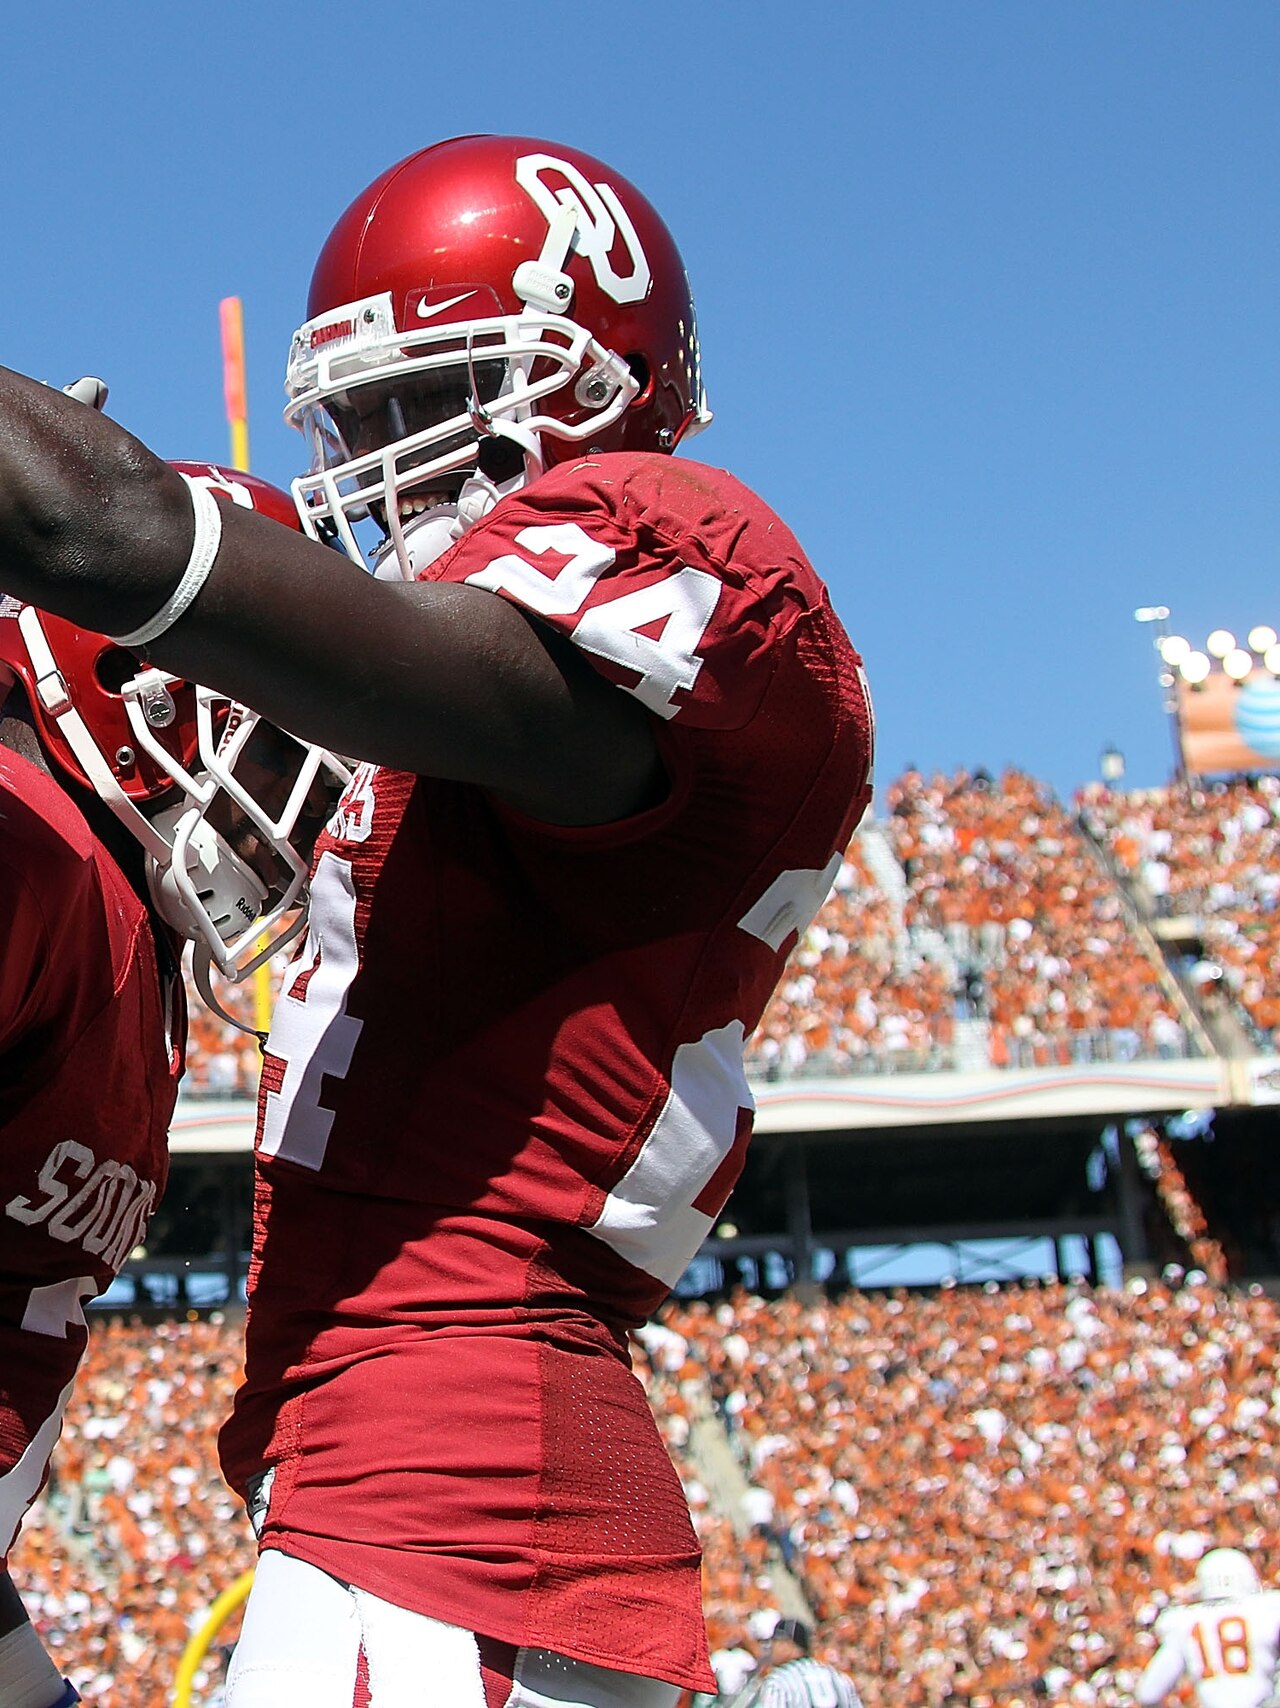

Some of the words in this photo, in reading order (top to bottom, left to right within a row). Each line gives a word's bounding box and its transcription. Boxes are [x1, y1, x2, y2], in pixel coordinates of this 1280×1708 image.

[515, 153, 651, 304] OU
[464, 522, 722, 720] 24
[1191, 1615, 1250, 1679] 18
